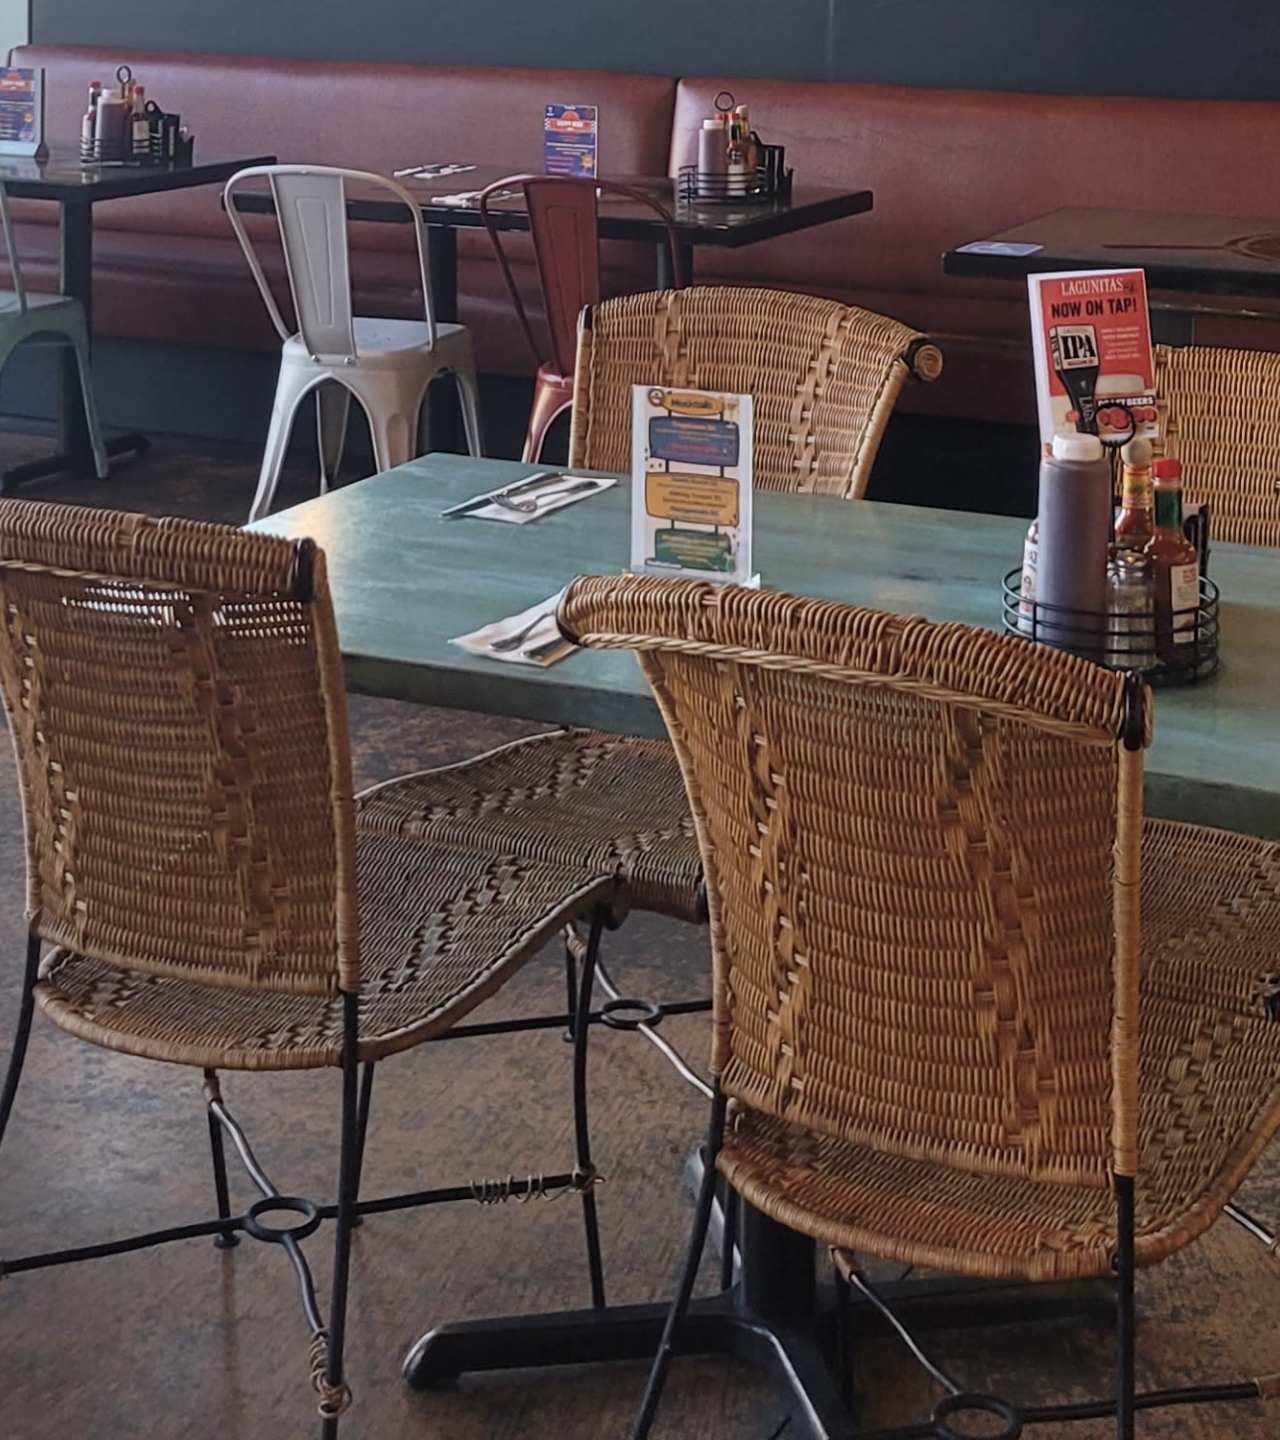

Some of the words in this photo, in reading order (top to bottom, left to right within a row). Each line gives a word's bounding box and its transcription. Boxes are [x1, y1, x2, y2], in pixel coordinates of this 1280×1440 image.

[1061, 278, 1124, 297] LAGUNITAS
[1051, 301, 1082, 318] NOW
[1085, 300, 1103, 316] ON
[1108, 297, 1137, 315] TAP!
[1061, 335, 1096, 360] IPA
